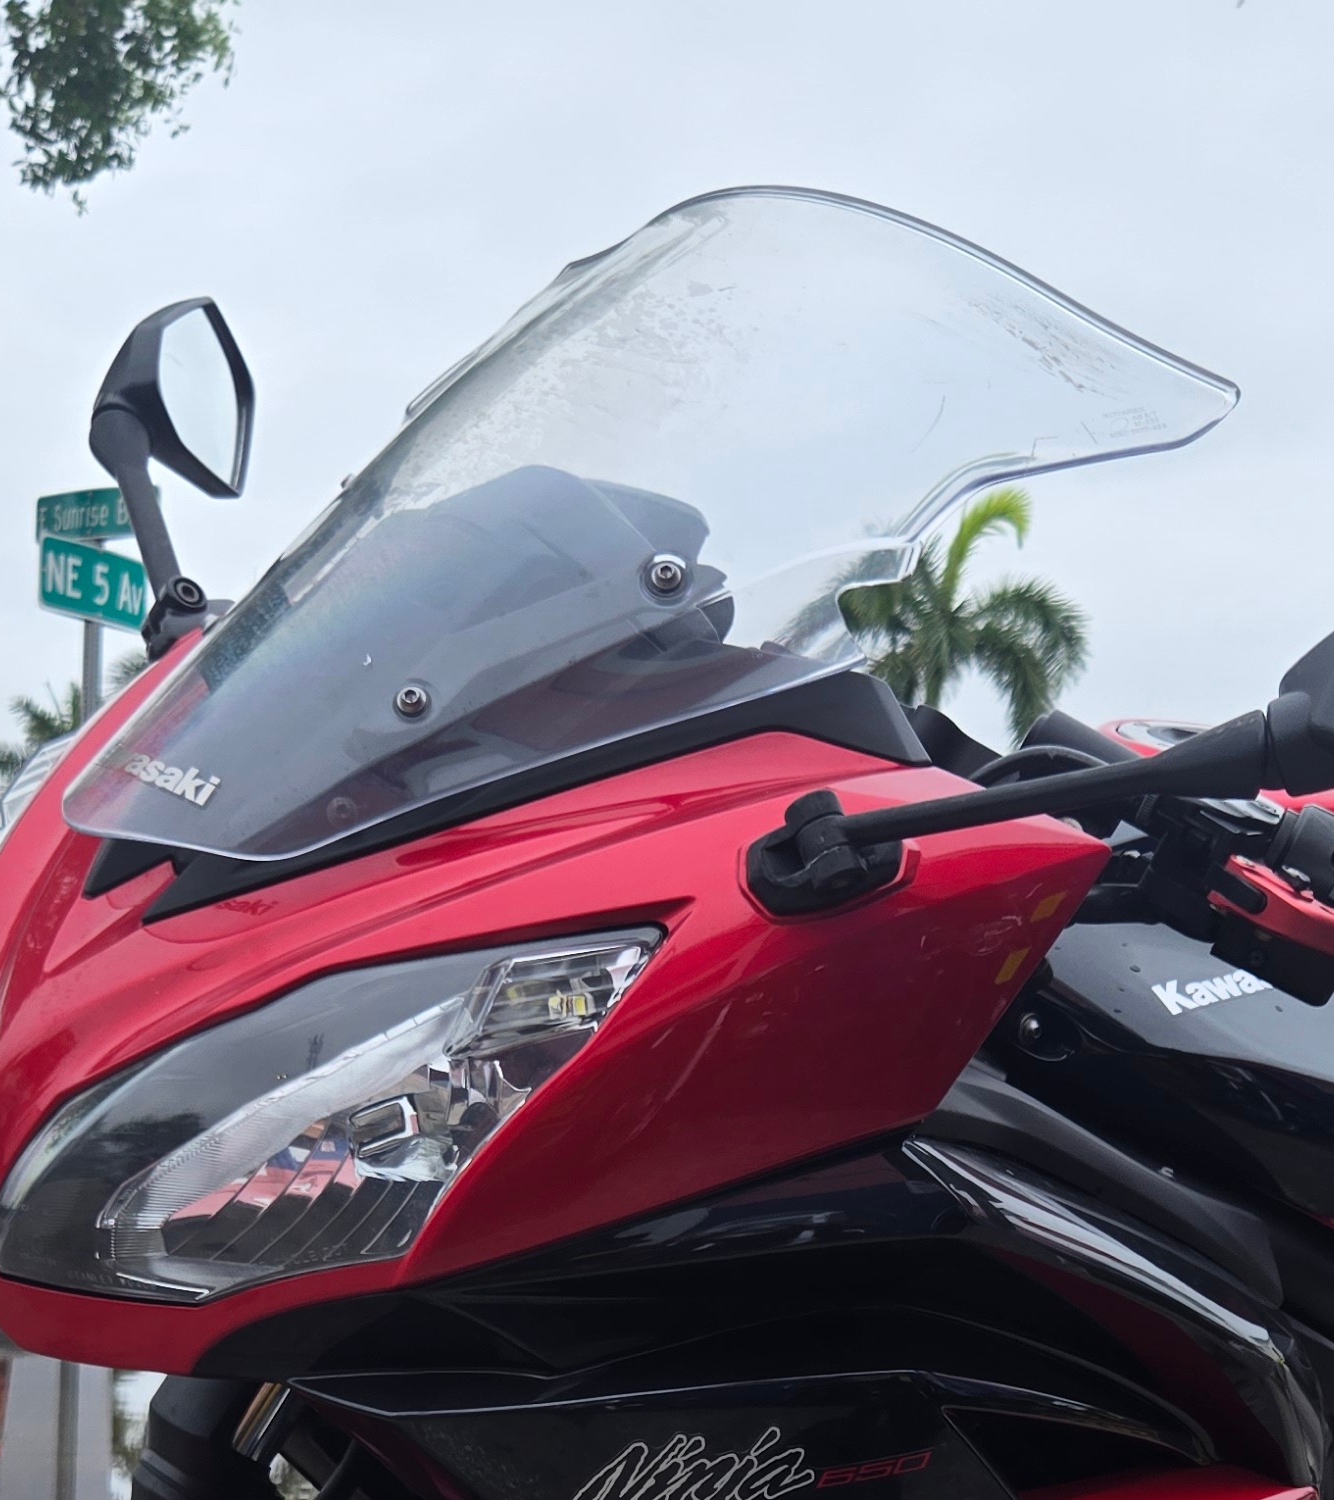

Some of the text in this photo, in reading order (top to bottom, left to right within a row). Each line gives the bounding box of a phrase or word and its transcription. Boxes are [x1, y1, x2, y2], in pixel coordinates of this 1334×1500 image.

[52, 503, 109, 532] Sunrise
[44, 551, 144, 616] NE 5 Av
[124, 754, 221, 807] asaki
[1151, 968, 1273, 1016] Kawa
[816, 1450, 933, 1489] 650
